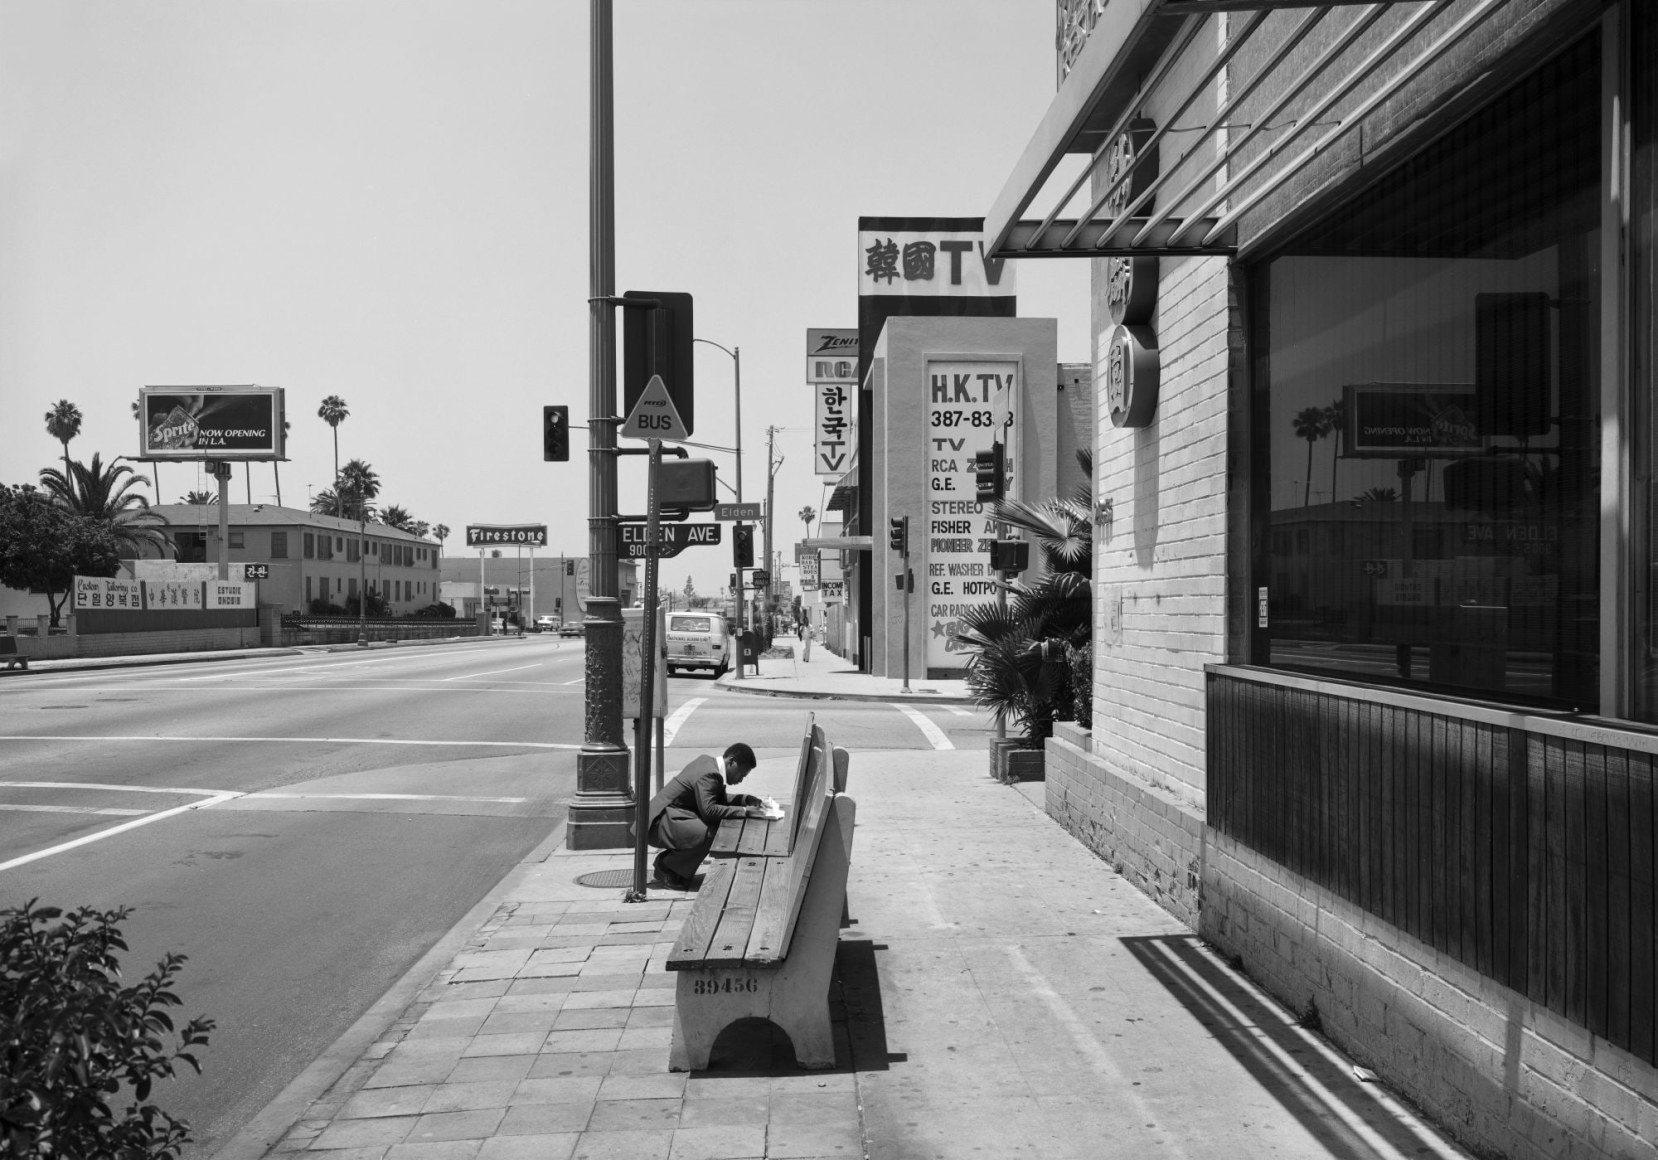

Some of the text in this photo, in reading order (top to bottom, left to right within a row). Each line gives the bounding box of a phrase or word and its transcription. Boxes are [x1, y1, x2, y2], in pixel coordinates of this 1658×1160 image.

[638, 414, 672, 430] BUS
[931, 411, 1014, 427] 387-833
[154, 421, 195, 442] Sprite
[199, 429, 266, 437] NOW OPENING
[932, 438, 965, 451] TV
[931, 459, 959, 472] RCA
[931, 477, 956, 491] G.E.
[721, 507, 753, 517] Elden
[931, 501, 983, 514] STEREO
[688, 526, 719, 541] AVE.
[931, 521, 1013, 534] FISHER AKI
[469, 528, 544, 543] Firestone
[930, 538, 973, 553] PIONEER
[929, 563, 946, 577] REF.
[948, 563, 984, 577] WASHER
[931, 582, 1013, 595] G.E. HOTPOT
[931, 603, 948, 617] CAR
[694, 978, 758, 995] 39456
